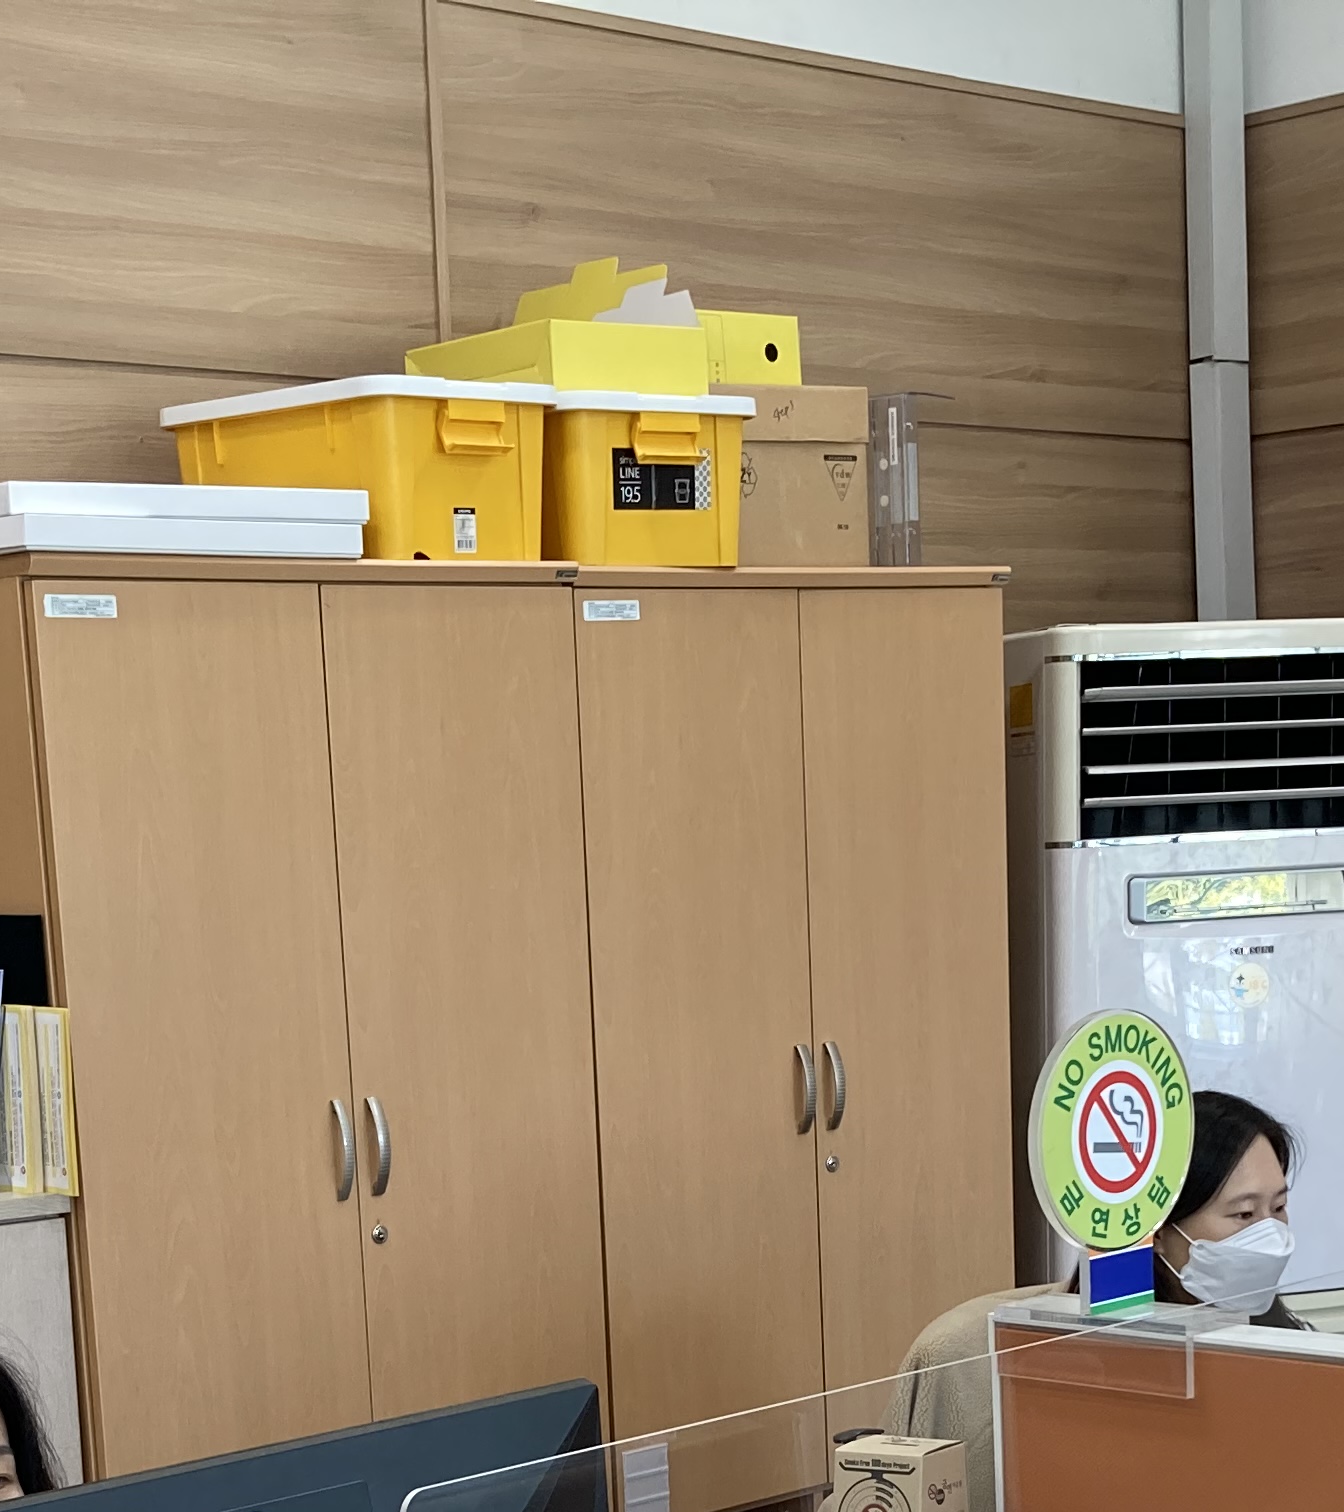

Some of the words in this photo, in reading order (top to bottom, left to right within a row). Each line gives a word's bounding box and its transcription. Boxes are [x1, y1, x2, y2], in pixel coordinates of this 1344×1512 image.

[619, 467, 641, 479] LINE
[1053, 1060, 1084, 1112] NO
[1088, 1024, 1184, 1110] SMOKING
[1059, 1175, 1171, 1239] 금연상담
